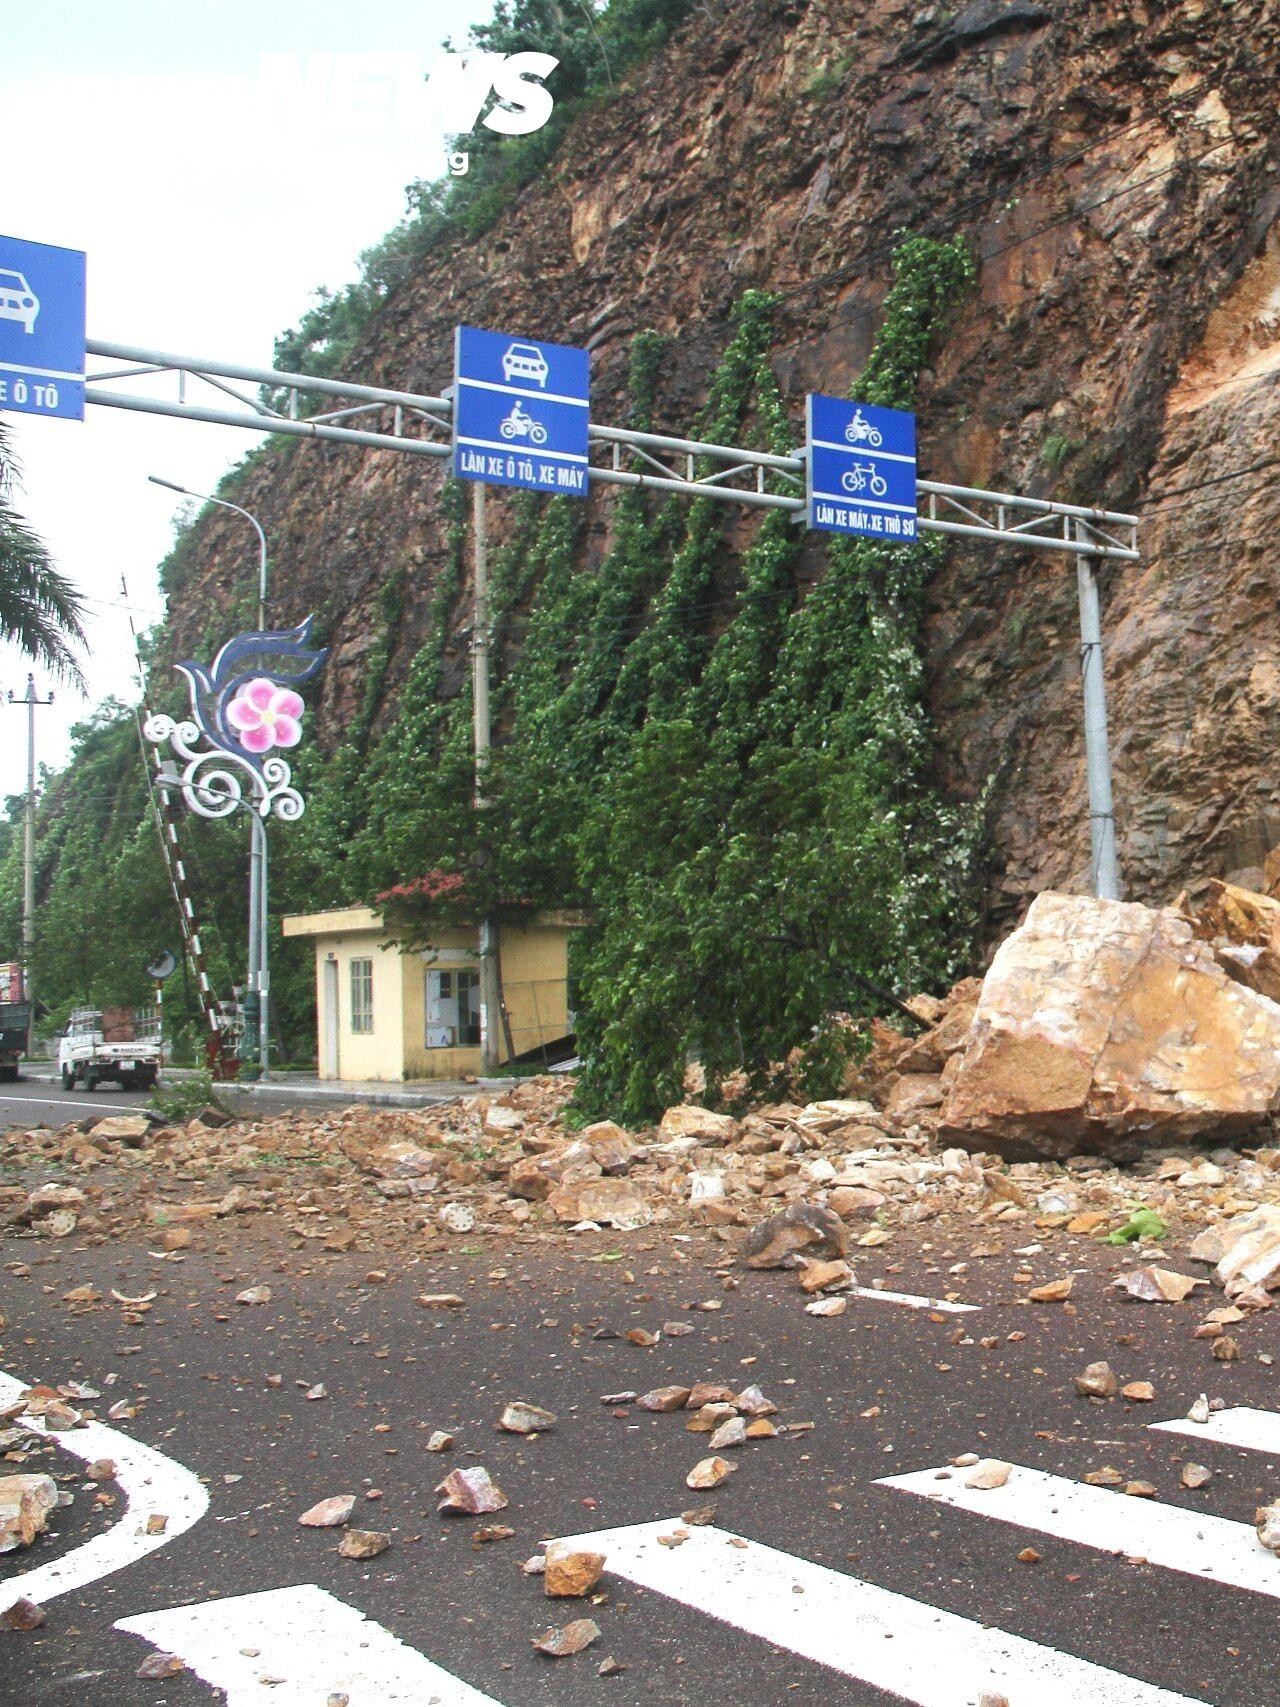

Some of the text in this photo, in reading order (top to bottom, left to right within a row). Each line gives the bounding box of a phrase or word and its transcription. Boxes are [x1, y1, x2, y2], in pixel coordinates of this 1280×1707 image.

[14, 378, 28, 404] Ô
[33, 383, 59, 409] TÔ
[461, 450, 584, 489] LÀN XE Ô TÔ, XE MÁY
[816, 503, 834, 524] LÀN
[835, 508, 848, 526] XE
[871, 514, 883, 531] XE
[884, 515, 900, 534] THÔ
